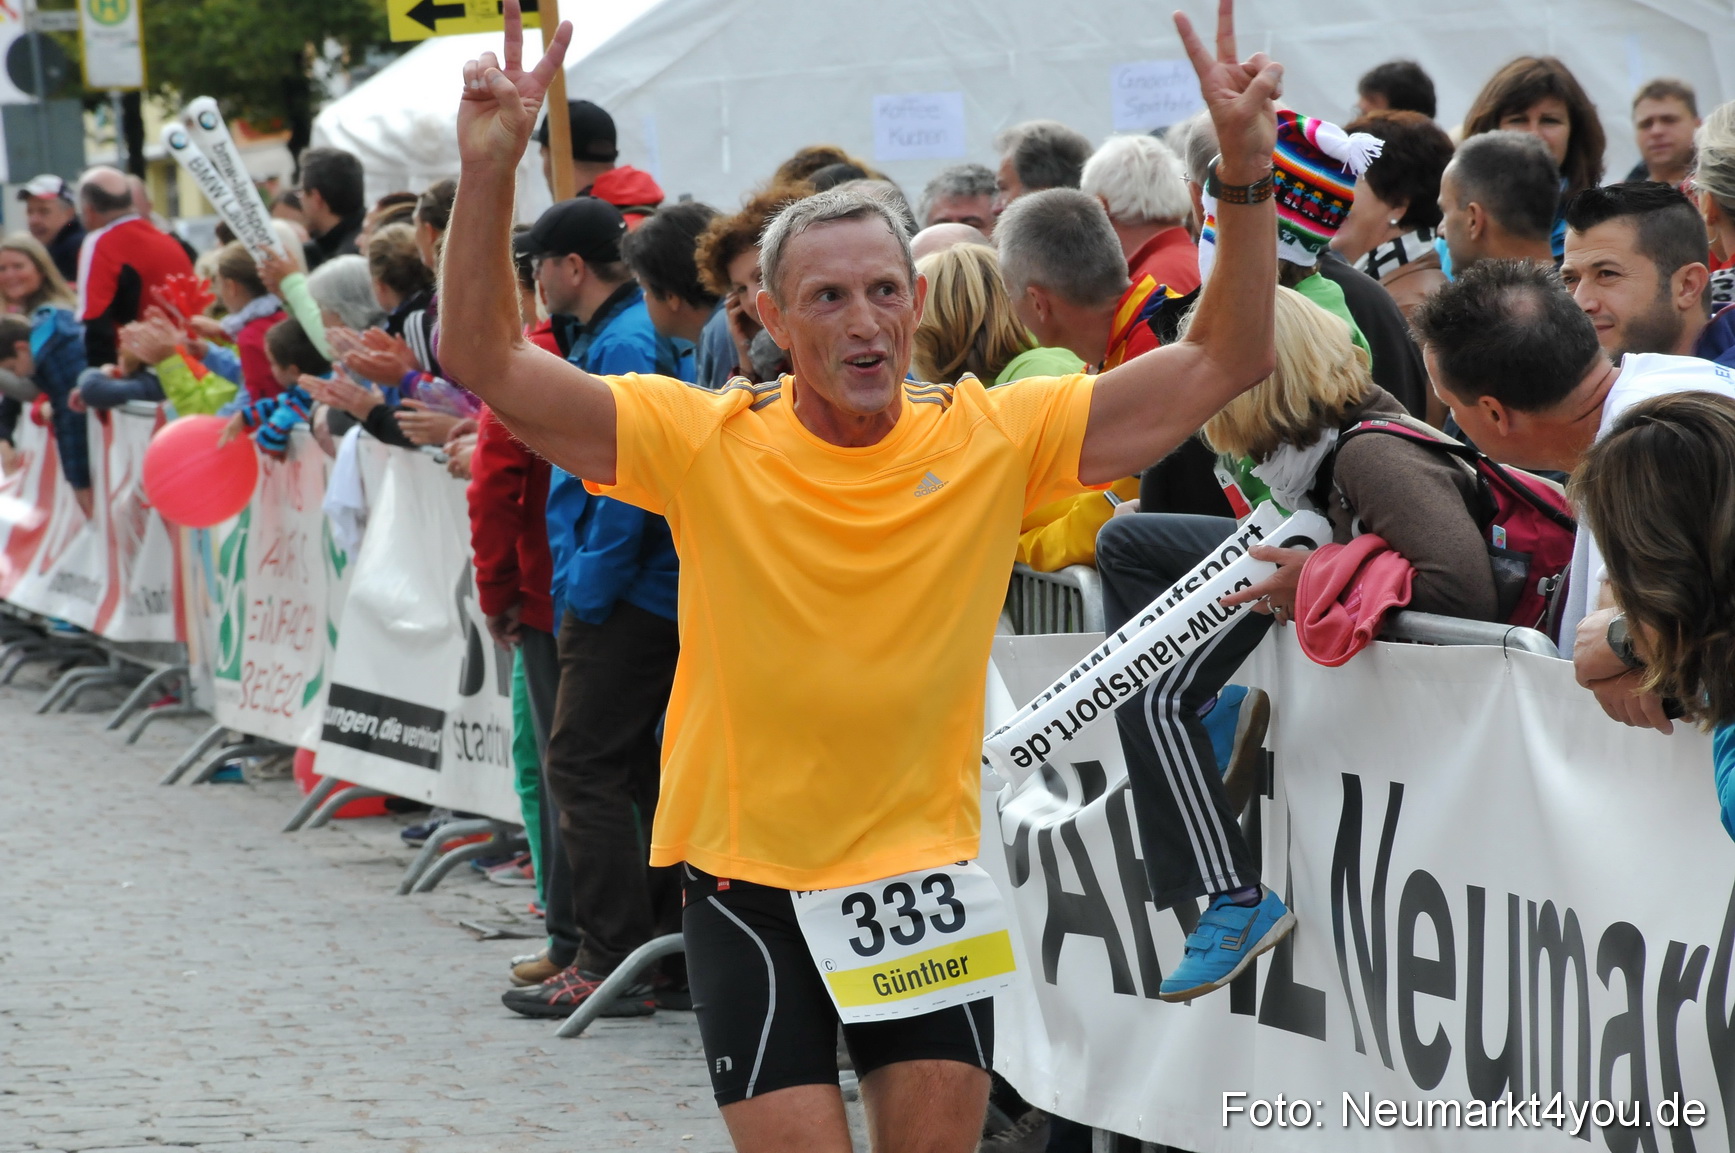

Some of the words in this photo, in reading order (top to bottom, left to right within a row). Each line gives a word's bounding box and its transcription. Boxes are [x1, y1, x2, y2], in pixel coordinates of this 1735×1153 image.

[913, 480, 950, 498] adidas
[379, 716, 403, 743] die
[841, 872, 966, 958] 333
[872, 955, 969, 997] Günther
